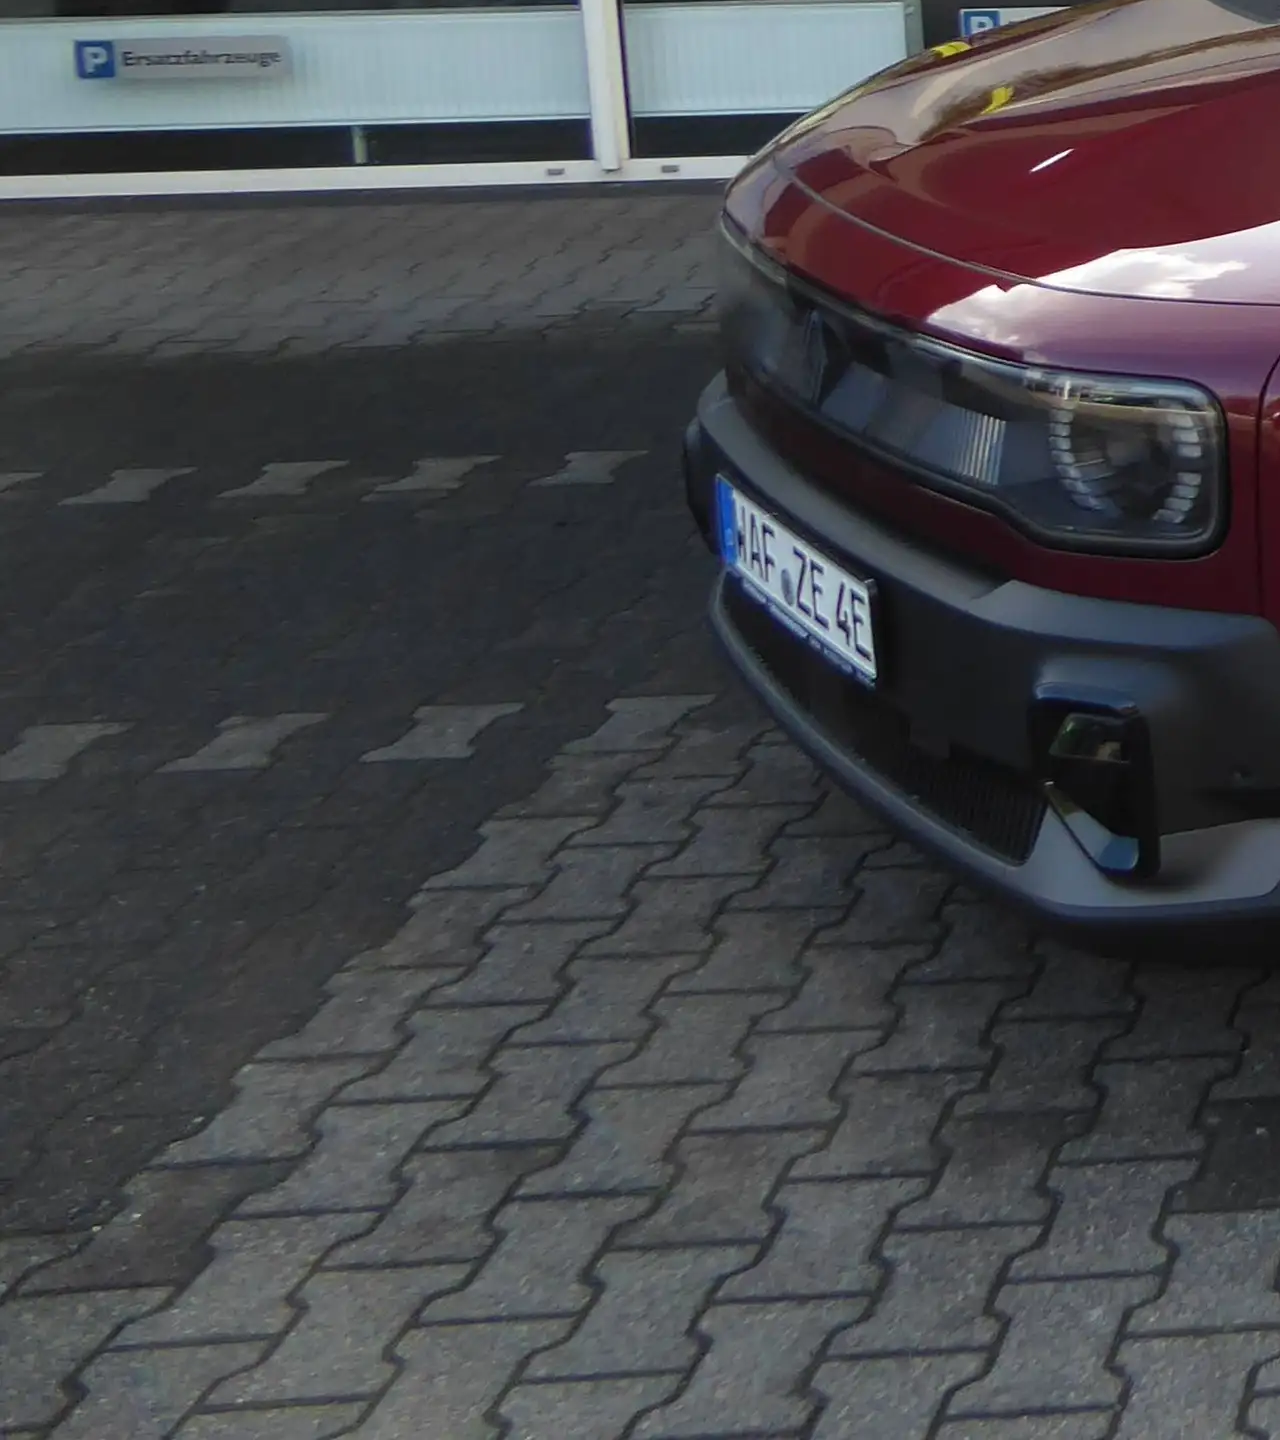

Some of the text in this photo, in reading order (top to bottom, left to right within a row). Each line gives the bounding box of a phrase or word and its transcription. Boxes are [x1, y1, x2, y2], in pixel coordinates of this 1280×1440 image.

[81, 46, 108, 74] P
[792, 545, 830, 631] ZE
[835, 581, 873, 663] 4E
